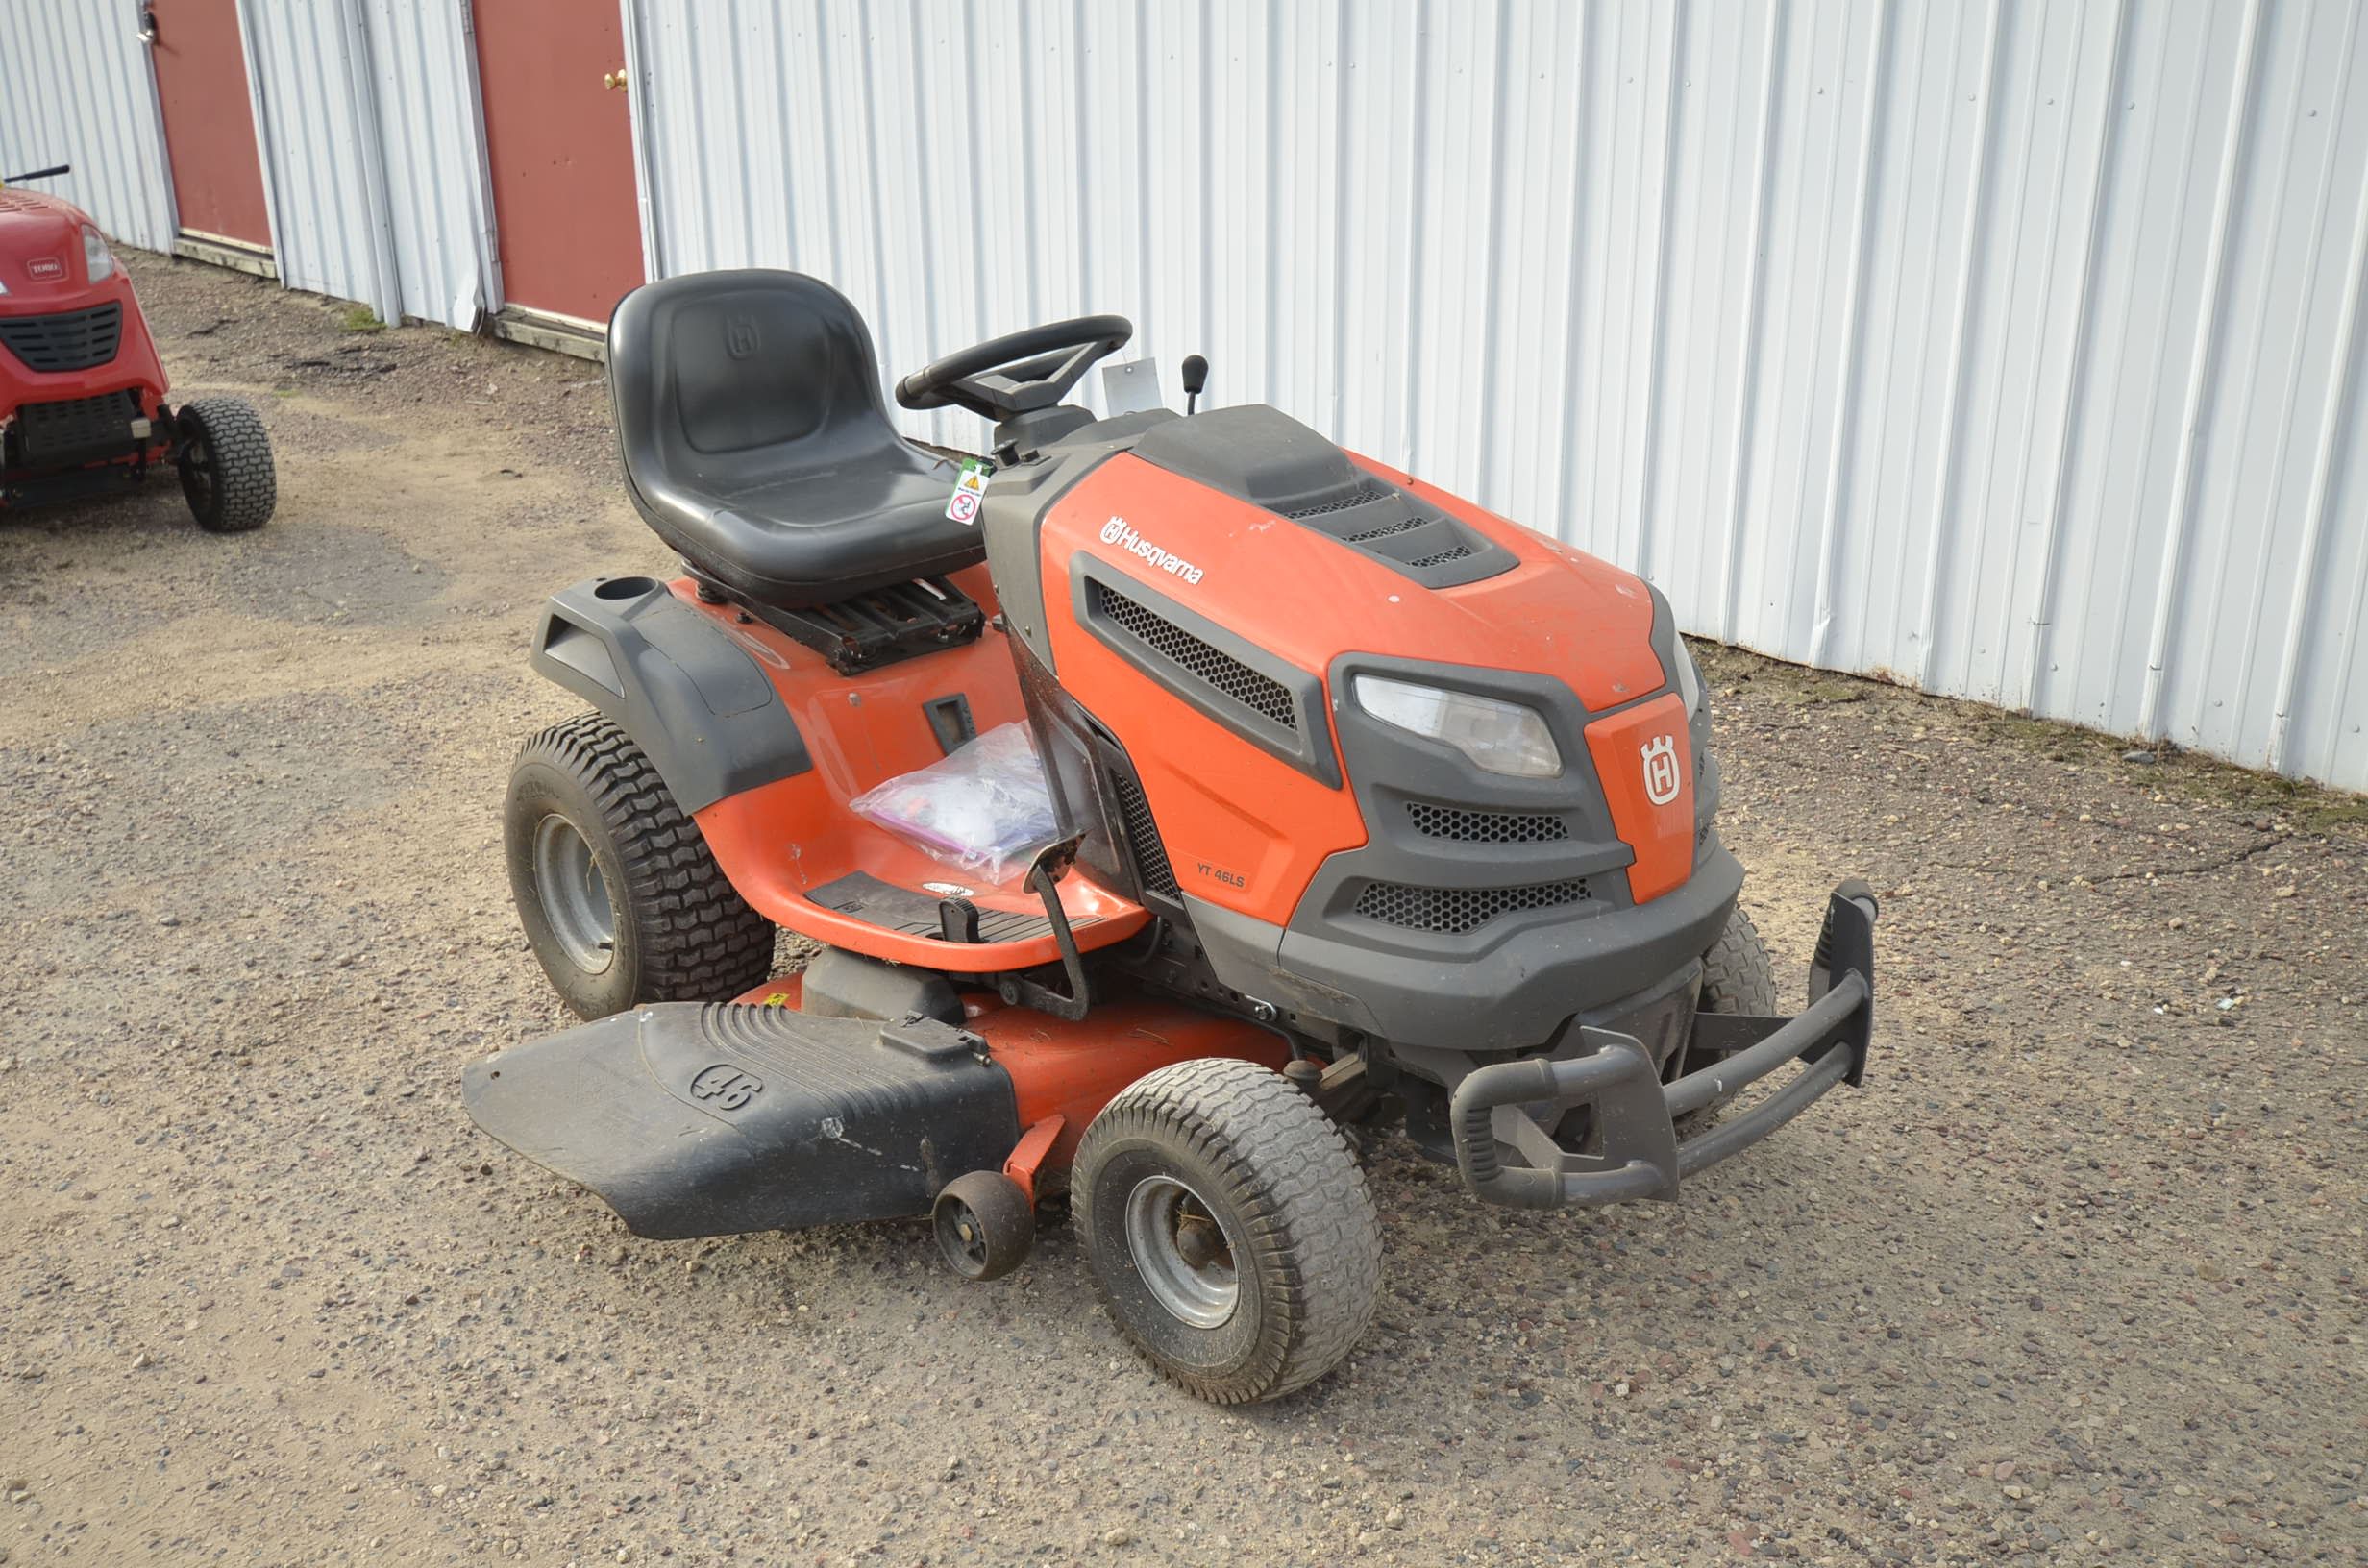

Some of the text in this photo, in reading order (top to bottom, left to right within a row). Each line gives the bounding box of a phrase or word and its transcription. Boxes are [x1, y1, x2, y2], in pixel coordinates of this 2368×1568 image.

[32, 262, 60, 274] TORO
[1118, 527, 1204, 585] Husqvarna
[1197, 862, 1245, 888] YT 46LS
[691, 1065, 763, 1111] 46
